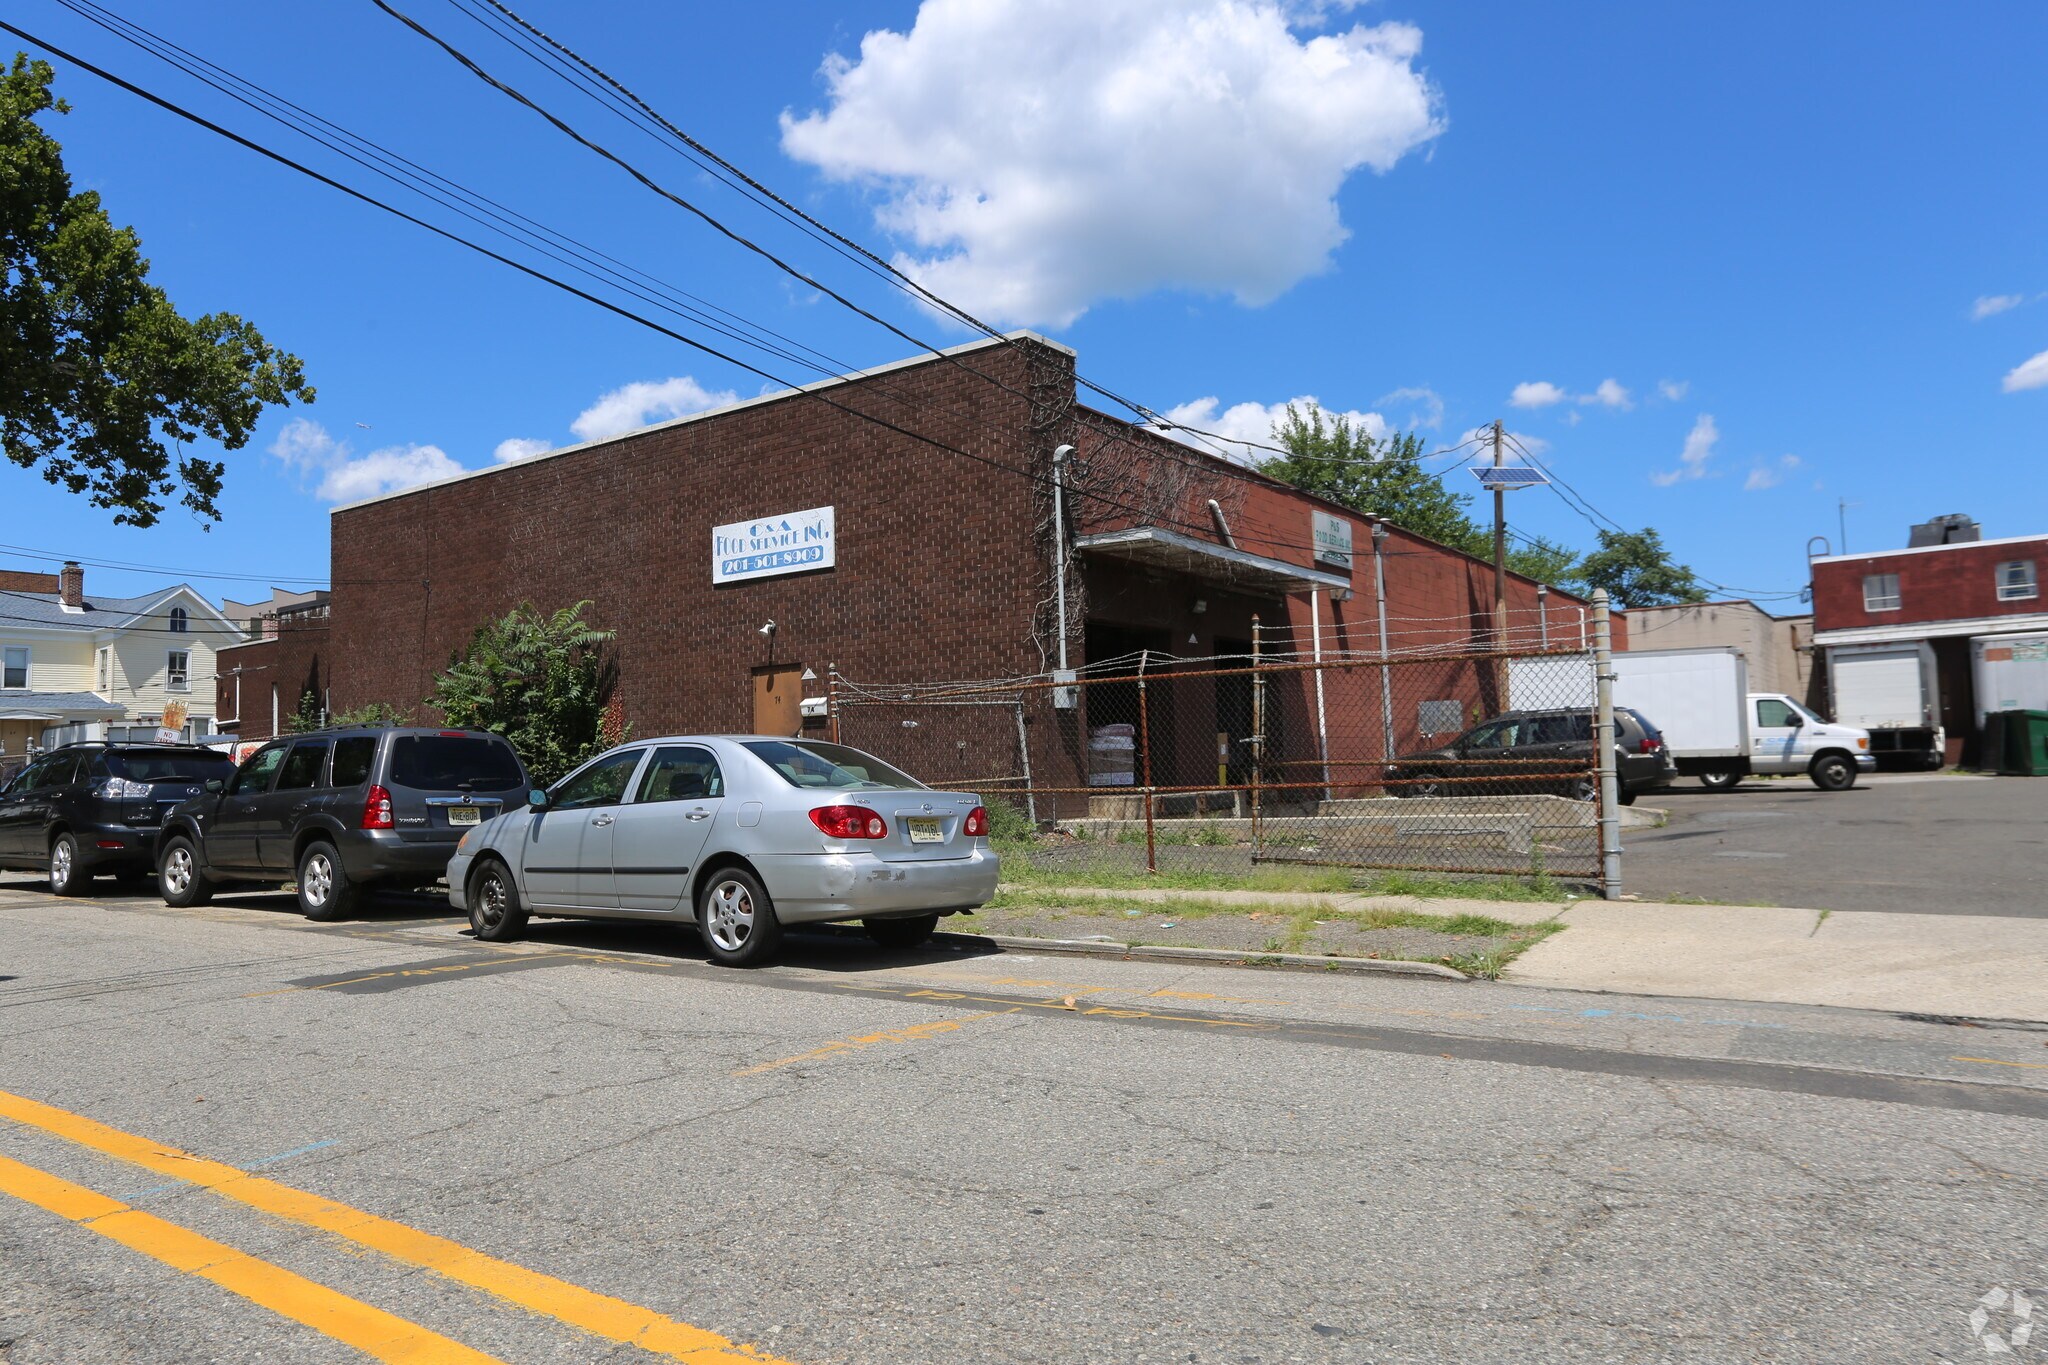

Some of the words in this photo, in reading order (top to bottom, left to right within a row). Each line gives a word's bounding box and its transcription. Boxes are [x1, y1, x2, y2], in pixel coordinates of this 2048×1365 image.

[716, 535, 746, 556] FOOD
[750, 530, 801, 551] SERVICE
[804, 518, 830, 542] INC.
[724, 547, 821, 573] 201-501-8909
[163, 731, 173, 739] NO
